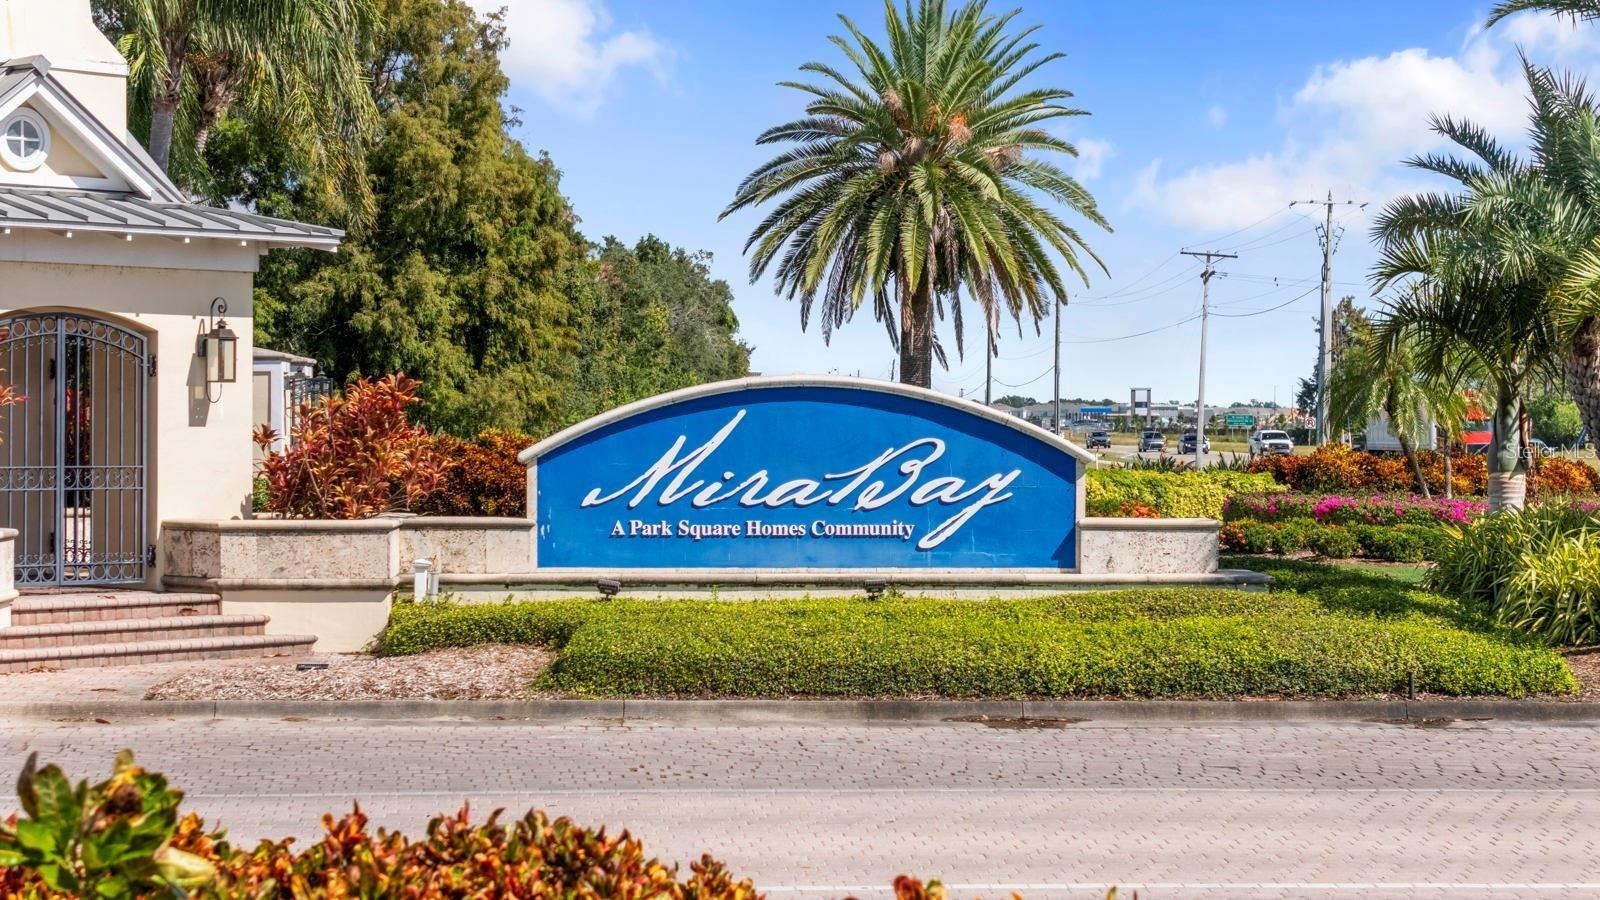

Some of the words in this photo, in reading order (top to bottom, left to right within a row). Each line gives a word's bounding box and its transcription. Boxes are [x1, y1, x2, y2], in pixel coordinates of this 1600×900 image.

[581, 409, 1021, 549] MiraBay
[611, 520, 625, 536] A
[630, 520, 673, 536] Park
[678, 520, 741, 540] Square
[746, 520, 806, 536] Homes
[811, 519, 915, 540] Community
